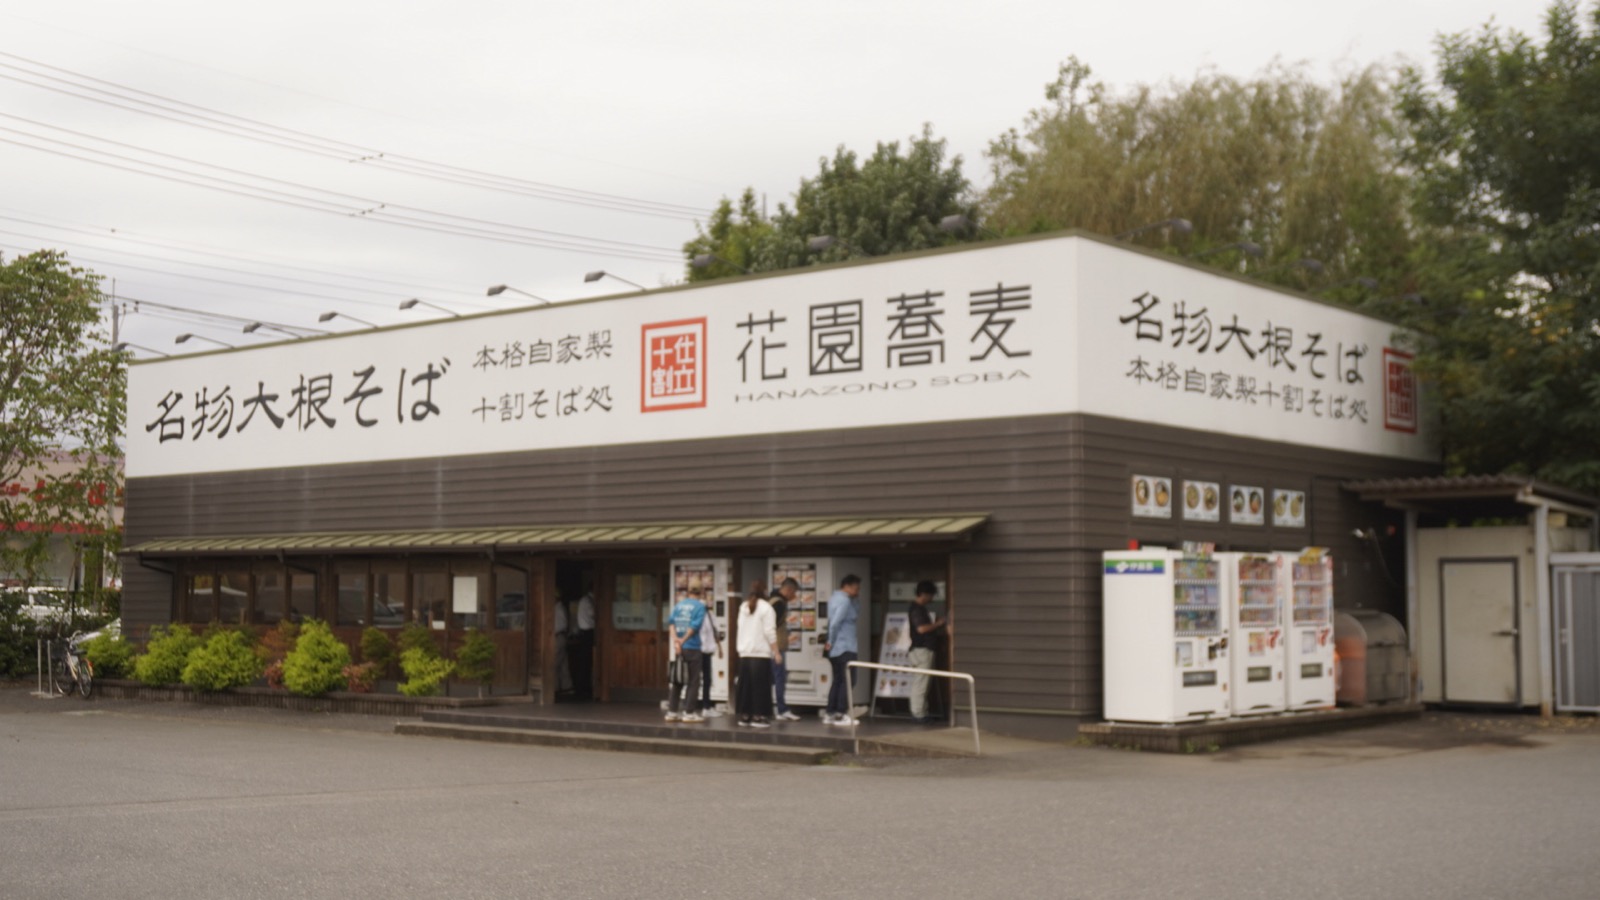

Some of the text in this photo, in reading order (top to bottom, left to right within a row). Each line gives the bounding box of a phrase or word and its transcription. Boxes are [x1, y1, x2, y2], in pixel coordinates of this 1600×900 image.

[472, 330, 612, 371] 本格自家製
[736, 282, 1032, 383] 花園蕎麦
[1119, 292, 1368, 384] 名物大根そば
[146, 357, 450, 444] 名物大根そば
[472, 386, 612, 423] 十割そば処
[734, 369, 1031, 403] HANAZONO SOBA
[1125, 355, 1369, 425] 本格自家製十割そば処
